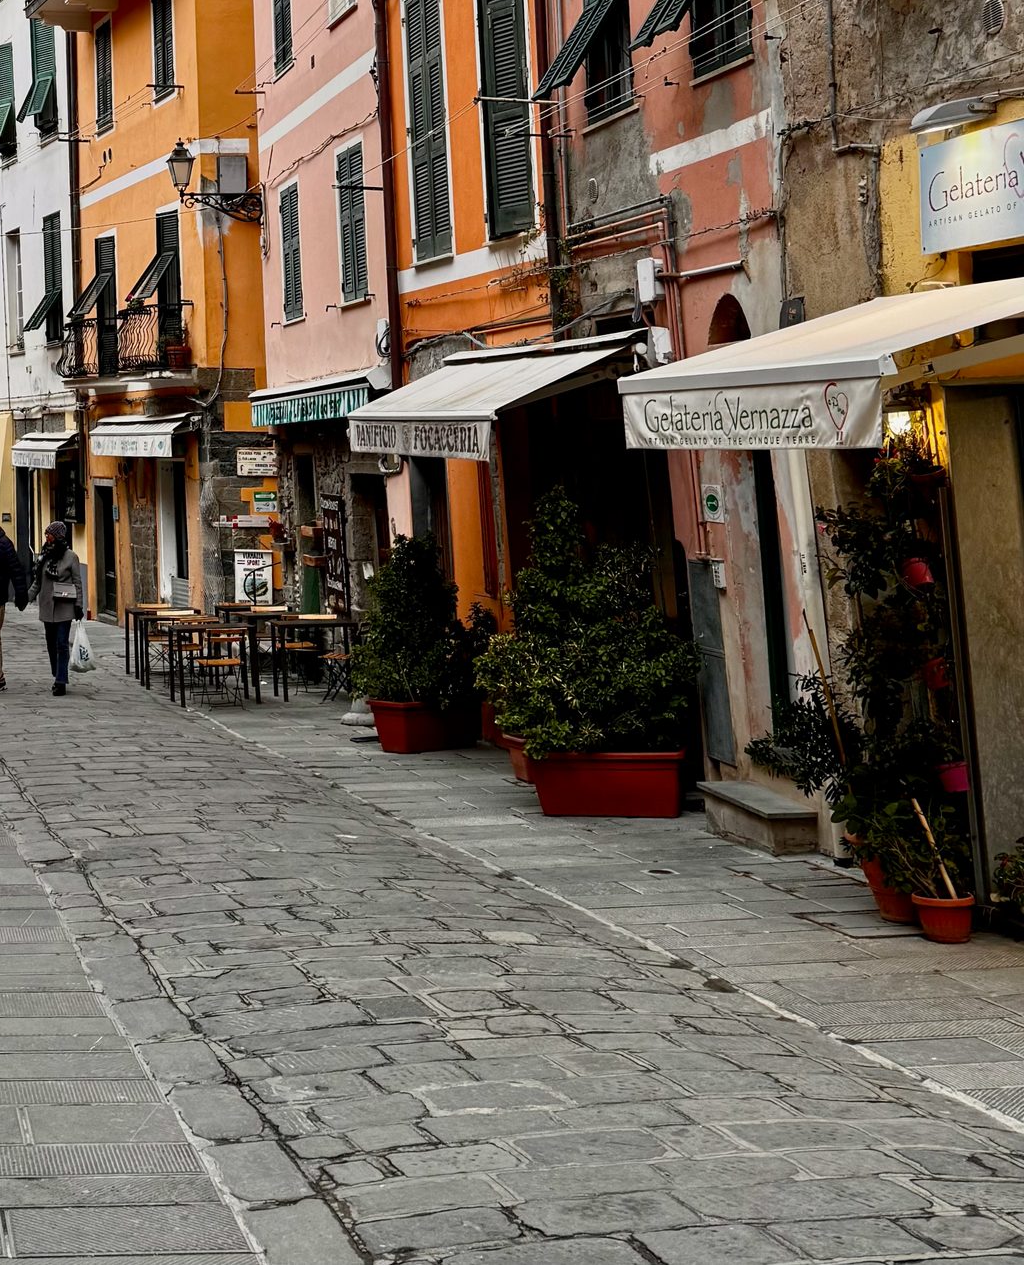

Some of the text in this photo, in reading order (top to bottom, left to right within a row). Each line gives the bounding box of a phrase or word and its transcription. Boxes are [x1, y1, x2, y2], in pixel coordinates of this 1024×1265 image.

[928, 166, 1019, 212] Gelateria
[928, 201, 1018, 229] ARTISAN GELATO OF
[644, 395, 723, 433] Gelateria
[725, 396, 813, 431] Vernazza
[355, 424, 480, 454] PANIFICIO FOCACCERIA
[679, 437, 708, 446] GELATO
[713, 437, 722, 445] OF
[728, 437, 743, 446] THE
[748, 436, 780, 445] CINQUE
[786, 435, 816, 445] TERRE
